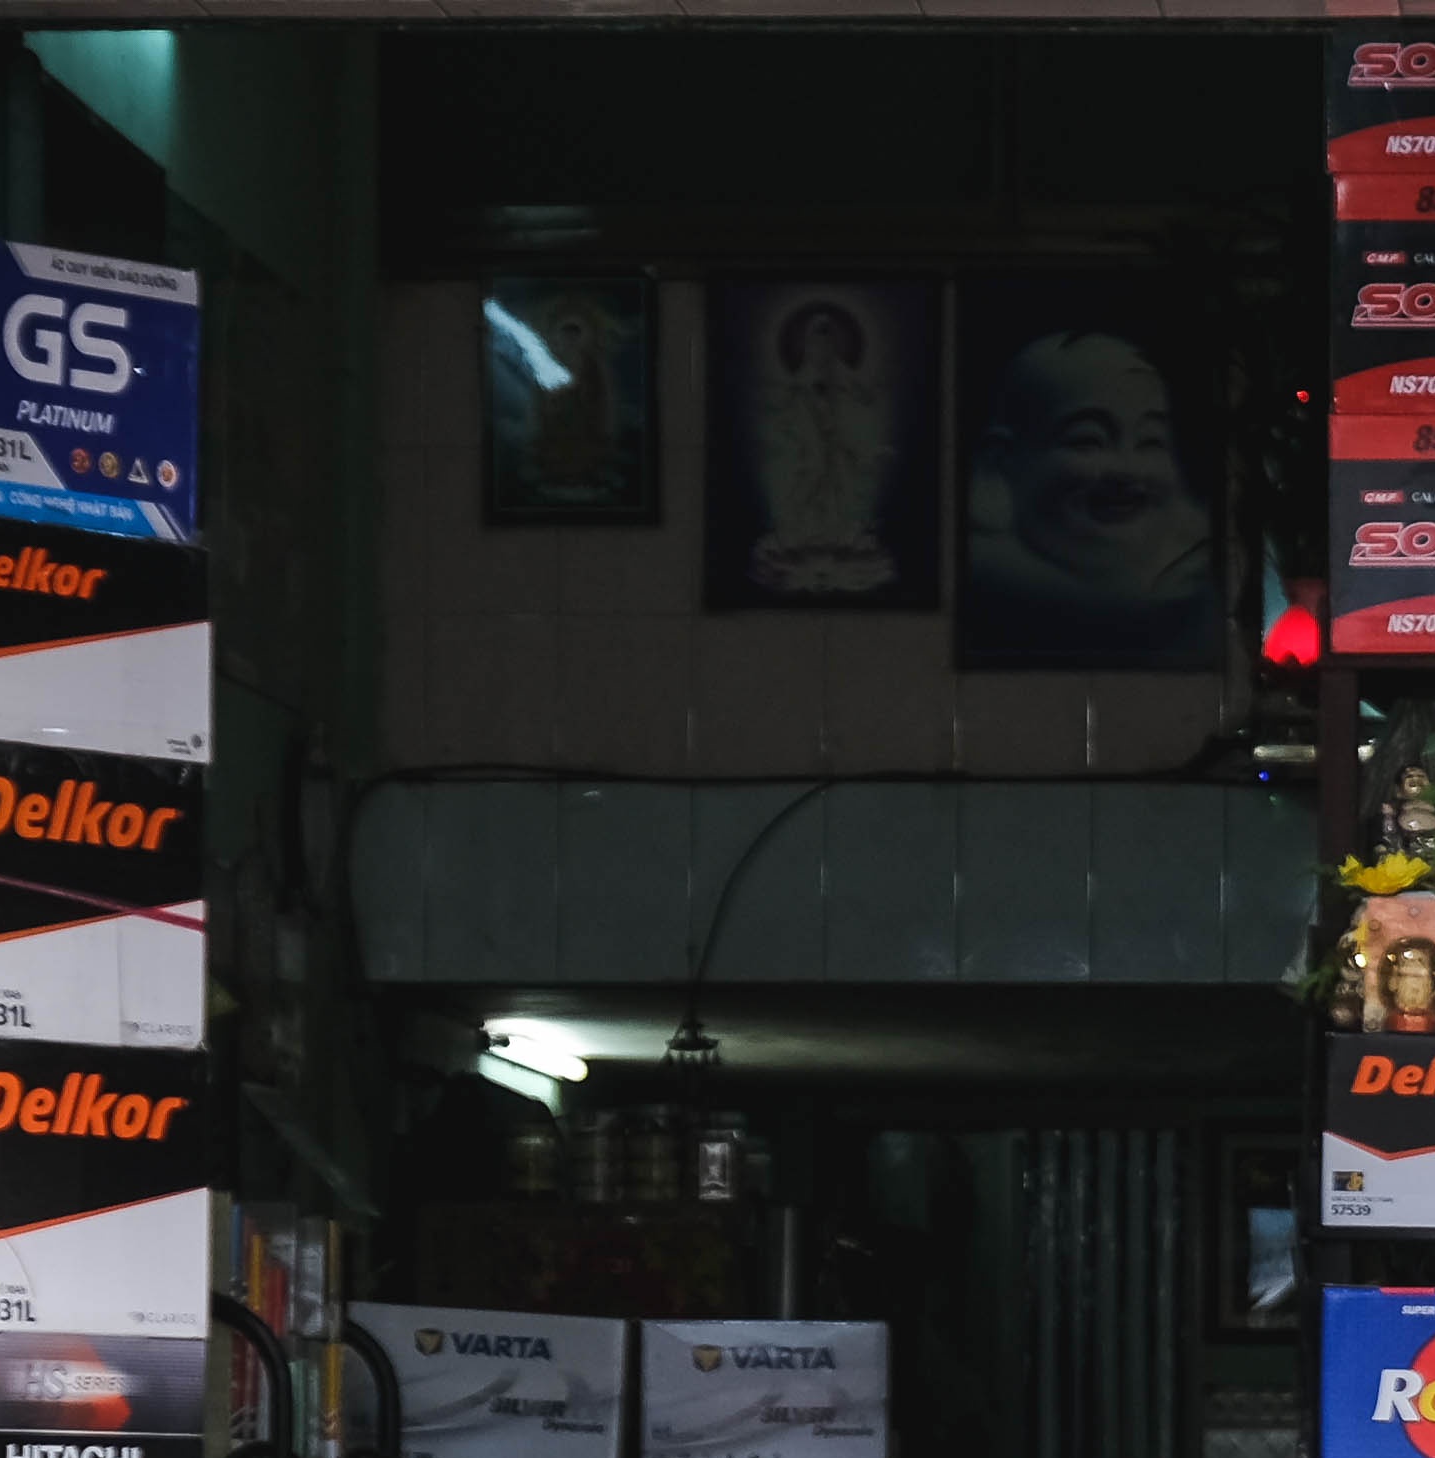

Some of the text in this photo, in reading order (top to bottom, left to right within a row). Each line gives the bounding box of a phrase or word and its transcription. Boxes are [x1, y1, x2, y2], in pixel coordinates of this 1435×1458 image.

[3, 293, 134, 394] GS
[1331, 1204, 1371, 1218] 57539
[1402, 1305, 1434, 1316] SUPER
